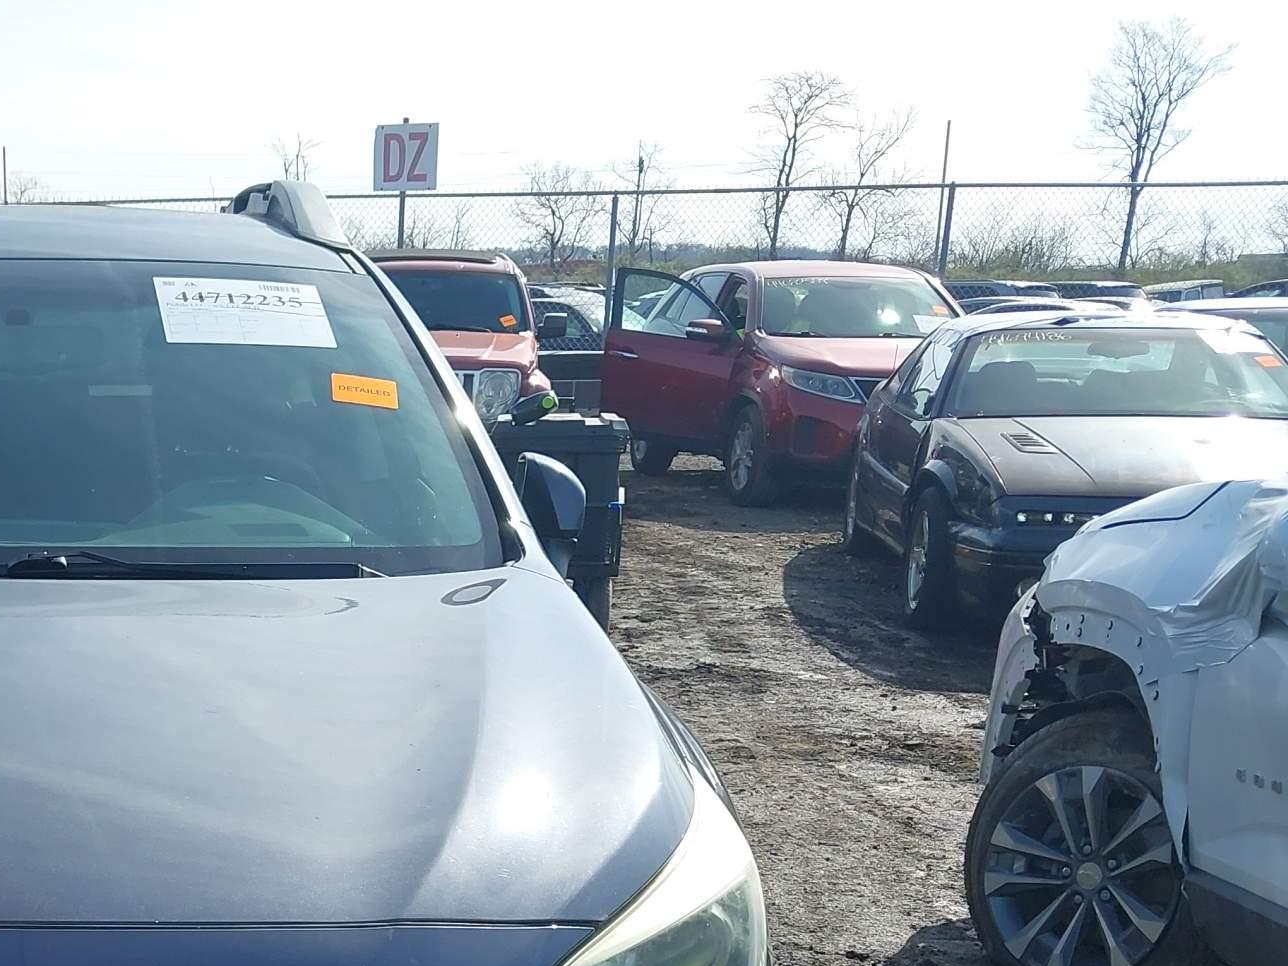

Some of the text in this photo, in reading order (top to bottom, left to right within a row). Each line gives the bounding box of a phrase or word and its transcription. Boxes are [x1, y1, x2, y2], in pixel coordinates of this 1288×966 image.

[382, 132, 429, 183] DZ
[174, 289, 304, 309] 44712235
[337, 384, 392, 398] DETAILED
